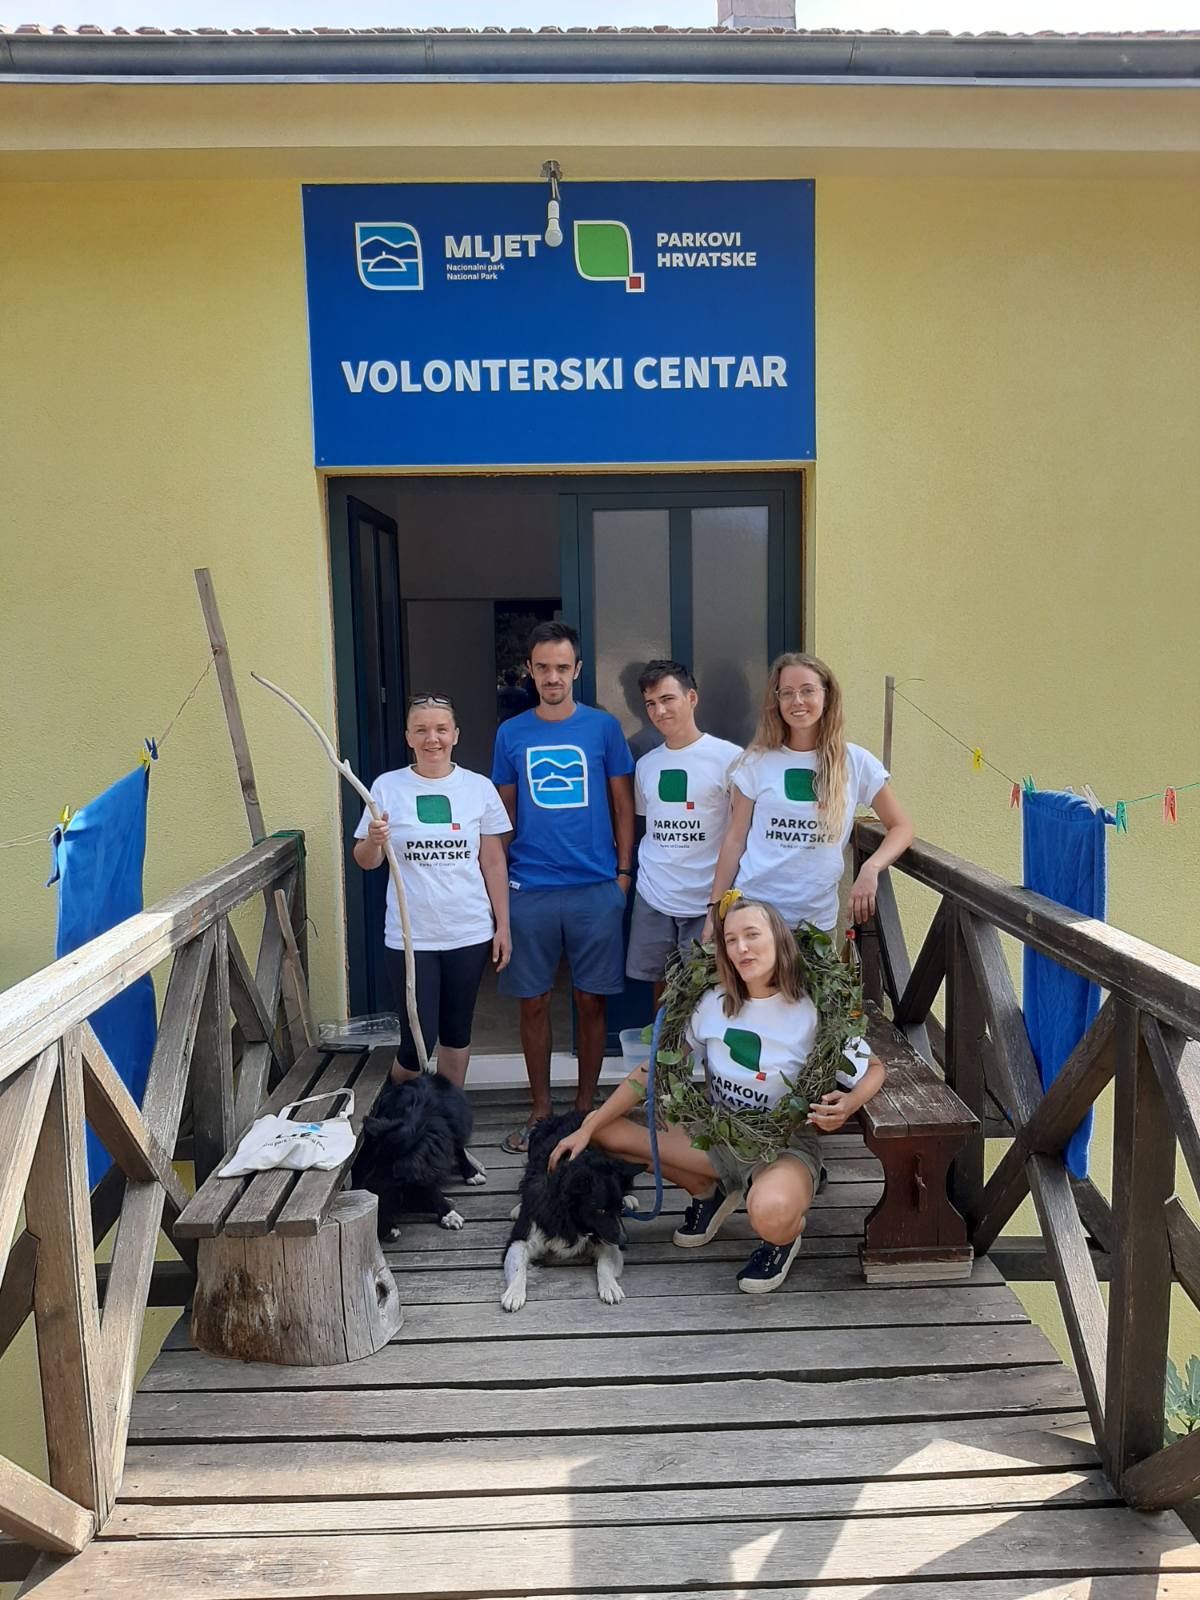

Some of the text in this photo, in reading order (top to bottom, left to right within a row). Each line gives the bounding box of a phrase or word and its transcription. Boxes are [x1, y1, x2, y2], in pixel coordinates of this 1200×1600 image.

[656, 231, 742, 247] PARKOVI
[444, 234, 542, 263] MLJET
[656, 251, 758, 268] HRVATSKE
[446, 263, 505, 273] Nacionalni park
[447, 272, 498, 280] National Park
[341, 355, 789, 393] VOLONTERSKI CENTAR
[654, 819, 701, 830] PARKOVI
[406, 839, 468, 850] PARKOVI
[403, 850, 472, 861] HRVATSKE
